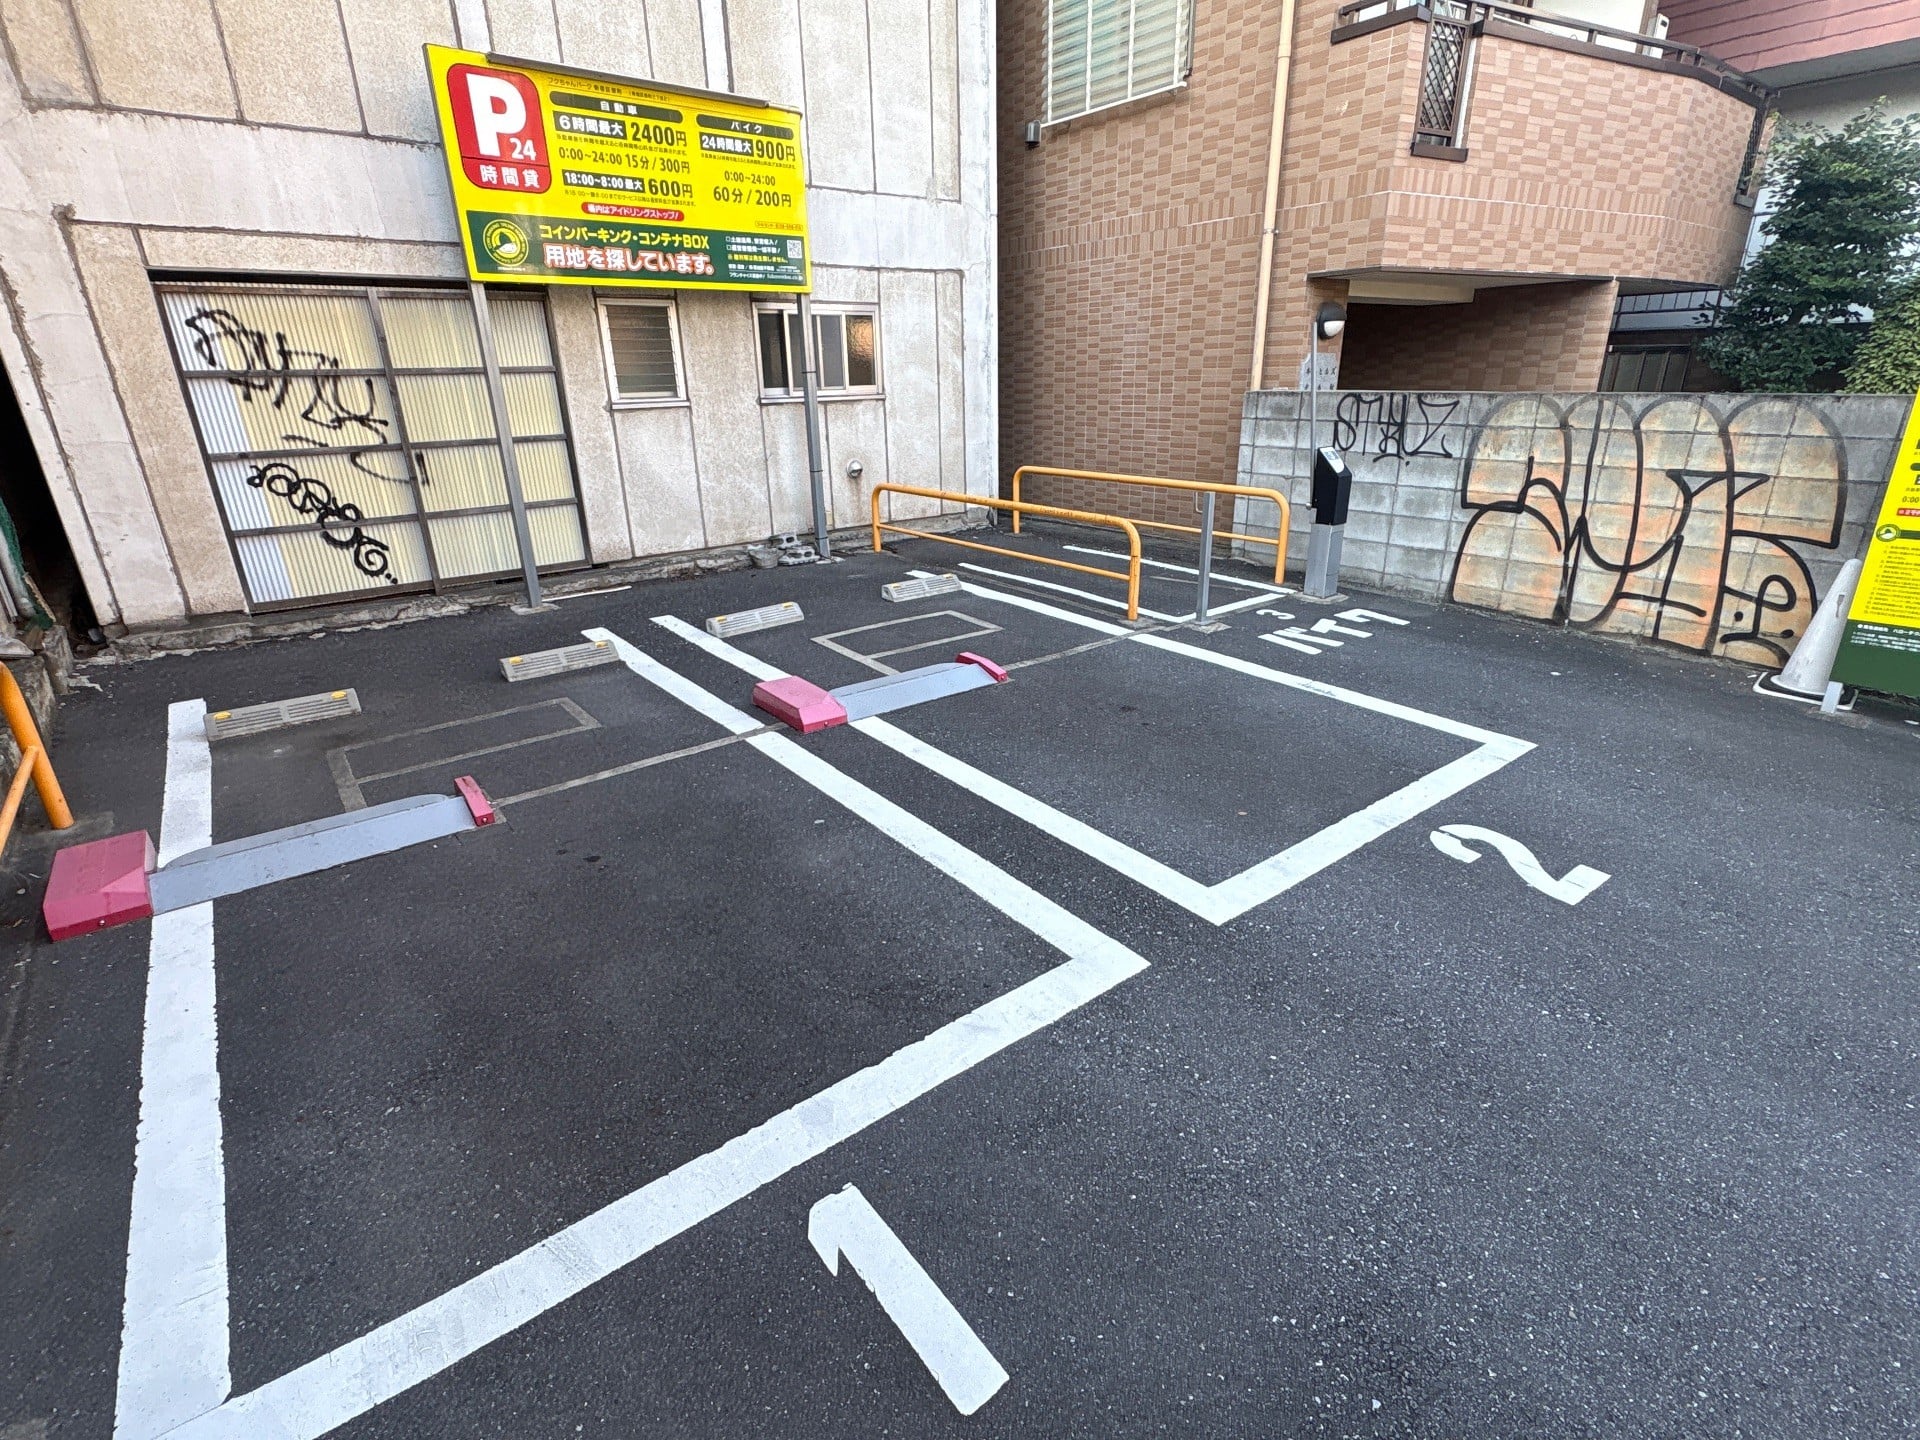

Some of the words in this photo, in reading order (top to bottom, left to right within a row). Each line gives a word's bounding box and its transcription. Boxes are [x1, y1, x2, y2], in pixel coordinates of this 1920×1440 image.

[465, 73, 527, 157] P
[509, 137, 537, 161] 24
[600, 101, 637, 115] 自動車
[560, 115, 623, 137] 6時間最大
[630, 122, 687, 147] 2400円
[731, 121, 762, 134] バイク
[756, 139, 796, 162] 900円
[480, 164, 540, 188] 時間貸
[648, 179, 693, 198] 600円
[543, 242, 715, 276] 用地を探しています。
[1256, 609, 1296, 620] 3
[1430, 824, 1612, 906] 2
[808, 1182, 1010, 1416] 1
